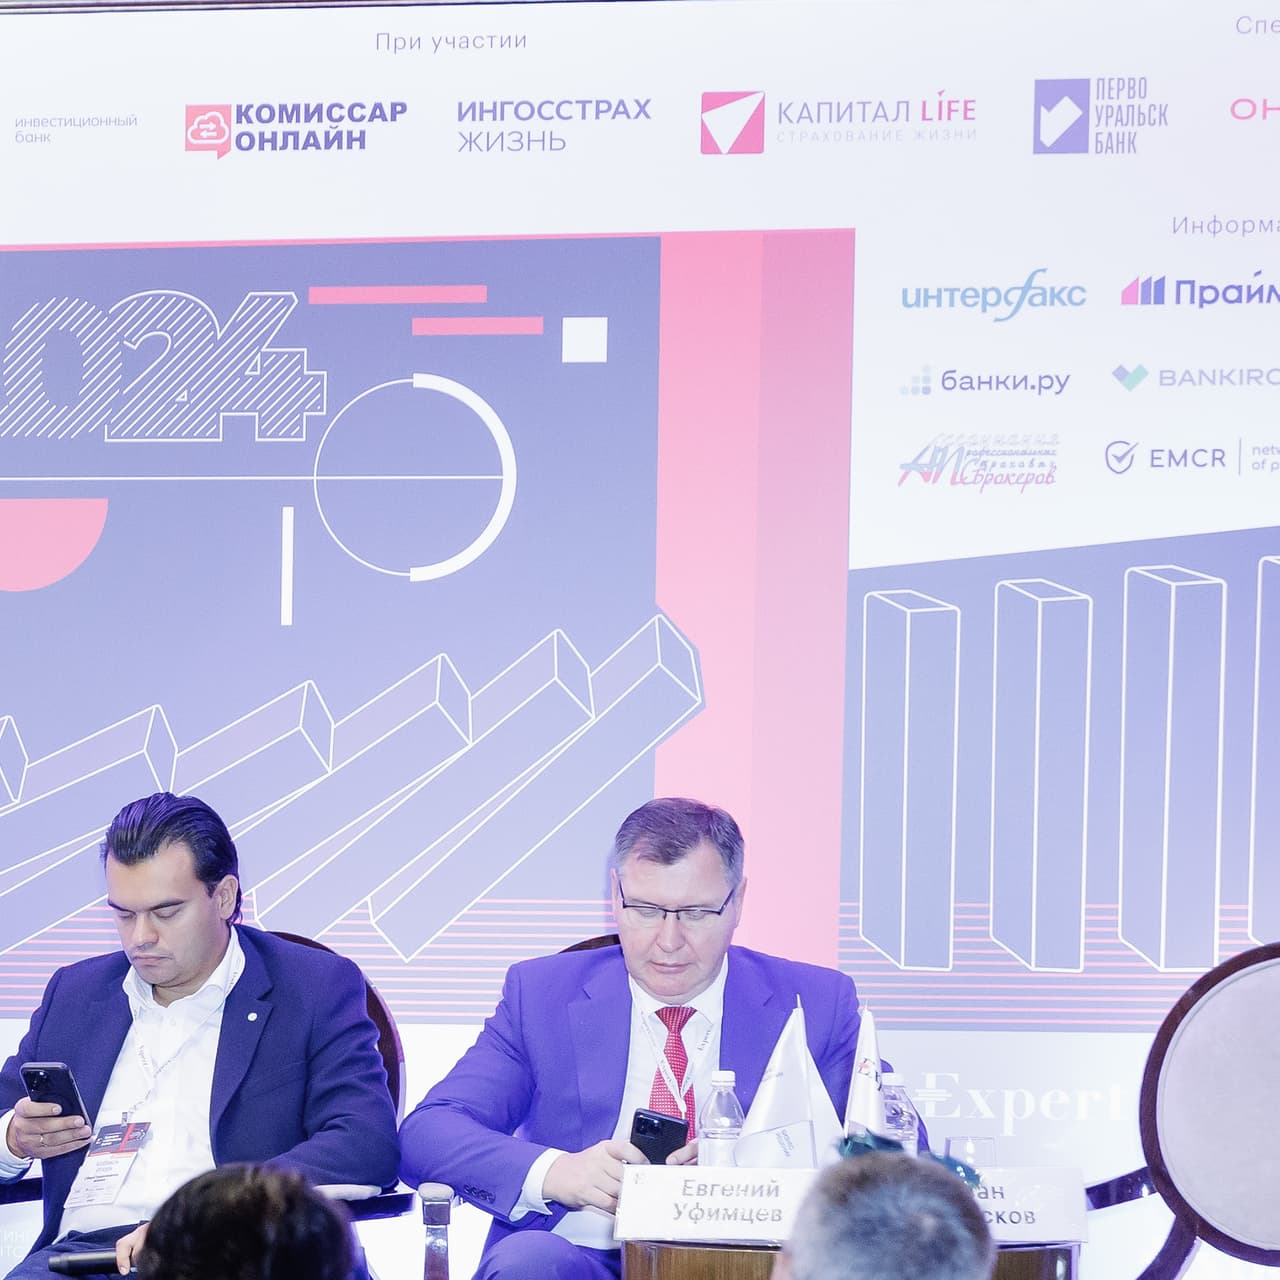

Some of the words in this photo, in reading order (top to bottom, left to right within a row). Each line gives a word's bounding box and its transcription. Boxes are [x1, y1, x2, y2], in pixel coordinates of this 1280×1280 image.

[376, 33, 420, 54] При
[431, 33, 527, 54] участии
[1096, 76, 1148, 101] ПЕРВО
[14, 113, 138, 129] инвестиционный
[235, 101, 408, 125] КОМИССАР
[457, 98, 652, 123] ИНГОССТРАХ
[777, 100, 910, 125] КАПИТАЛ
[1095, 103, 1169, 128] УРАЛЬСК
[14, 130, 52, 144] банк
[235, 125, 367, 152] ОНЛАЙН
[457, 130, 567, 153] ЖИЗНЬ
[776, 129, 904, 144] СТРАХОВАНИЕ
[912, 127, 977, 142] ЖИЗНИ
[1094, 131, 1138, 155] БАНК
[1172, 214, 1280, 237] Информ
[901, 267, 1088, 323] интерфакс
[940, 369, 1071, 396] банки.ру
[1150, 448, 1227, 469] EMCR
[913, 1071, 1129, 1137] Expert
[681, 1177, 781, 1199] Евгений
[672, 1201, 783, 1226] Уфимцев
[984, 1209, 1037, 1226] сков
